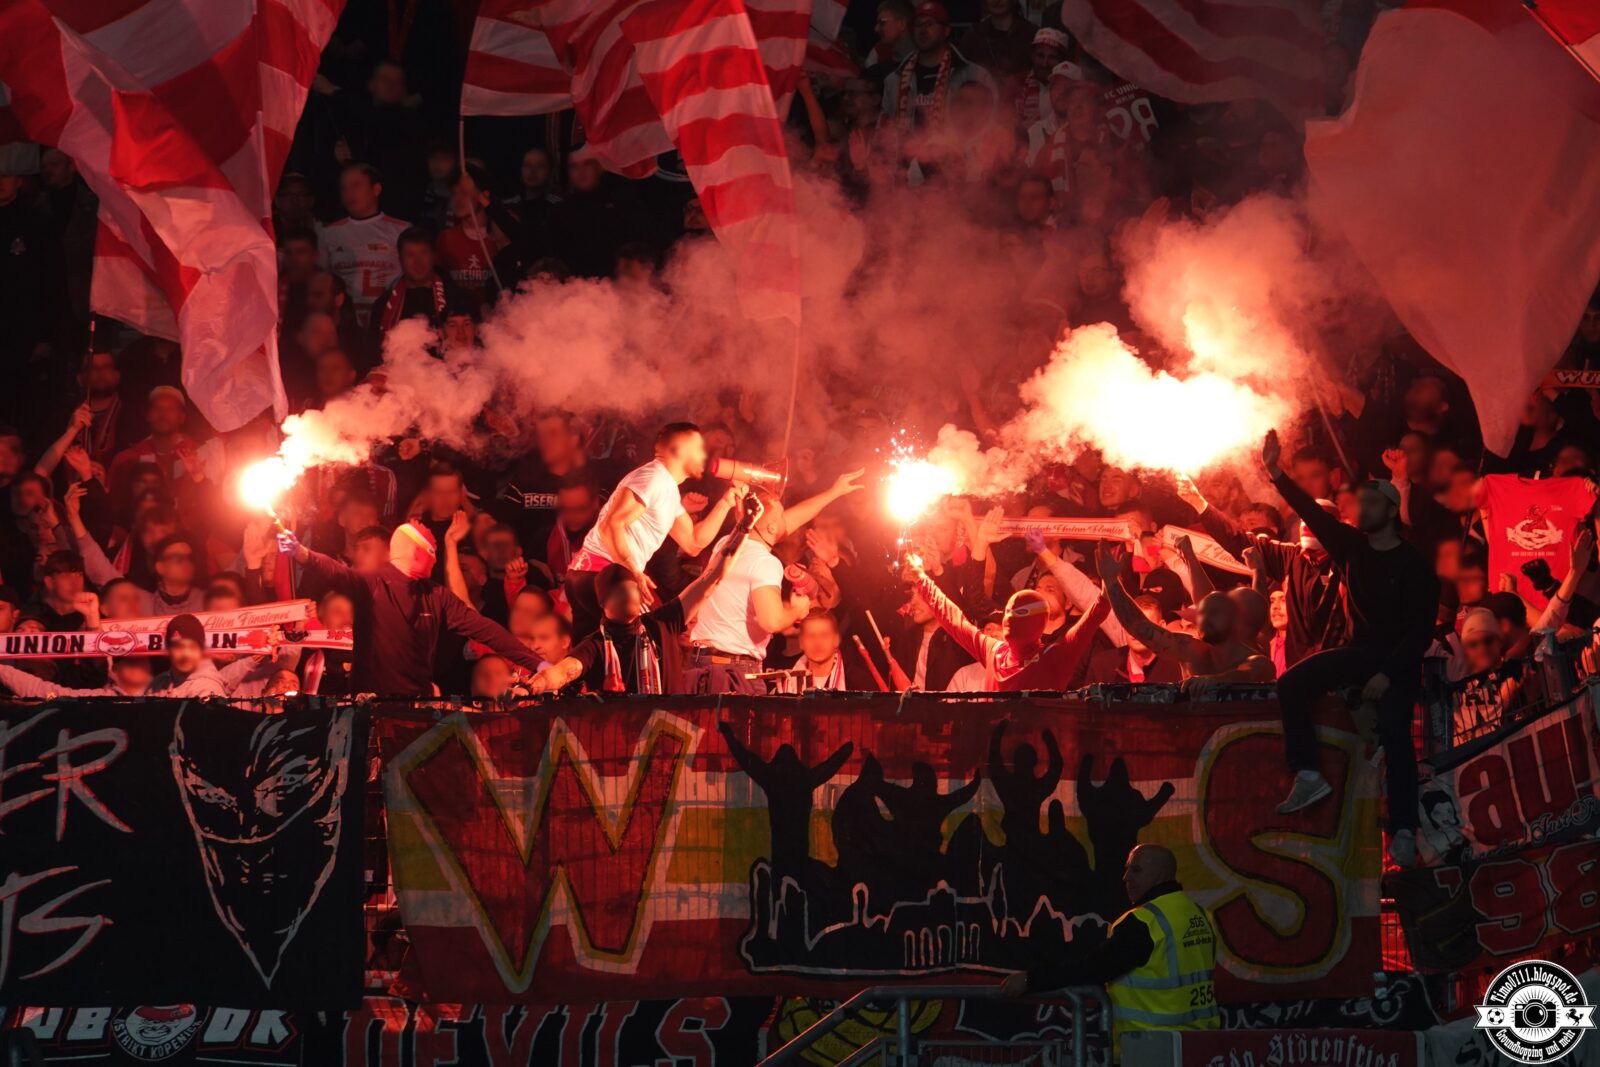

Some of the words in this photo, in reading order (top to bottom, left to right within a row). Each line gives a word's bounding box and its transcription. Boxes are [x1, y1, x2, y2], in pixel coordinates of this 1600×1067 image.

[6, 634, 85, 654] UNION
[148, 633, 238, 651] BIN
[1190, 983, 1214, 1006] 255
[112, 1018, 147, 1058] ISTRIKT
[202, 1006, 294, 1045] DK
[343, 997, 732, 1067] DEVILS
